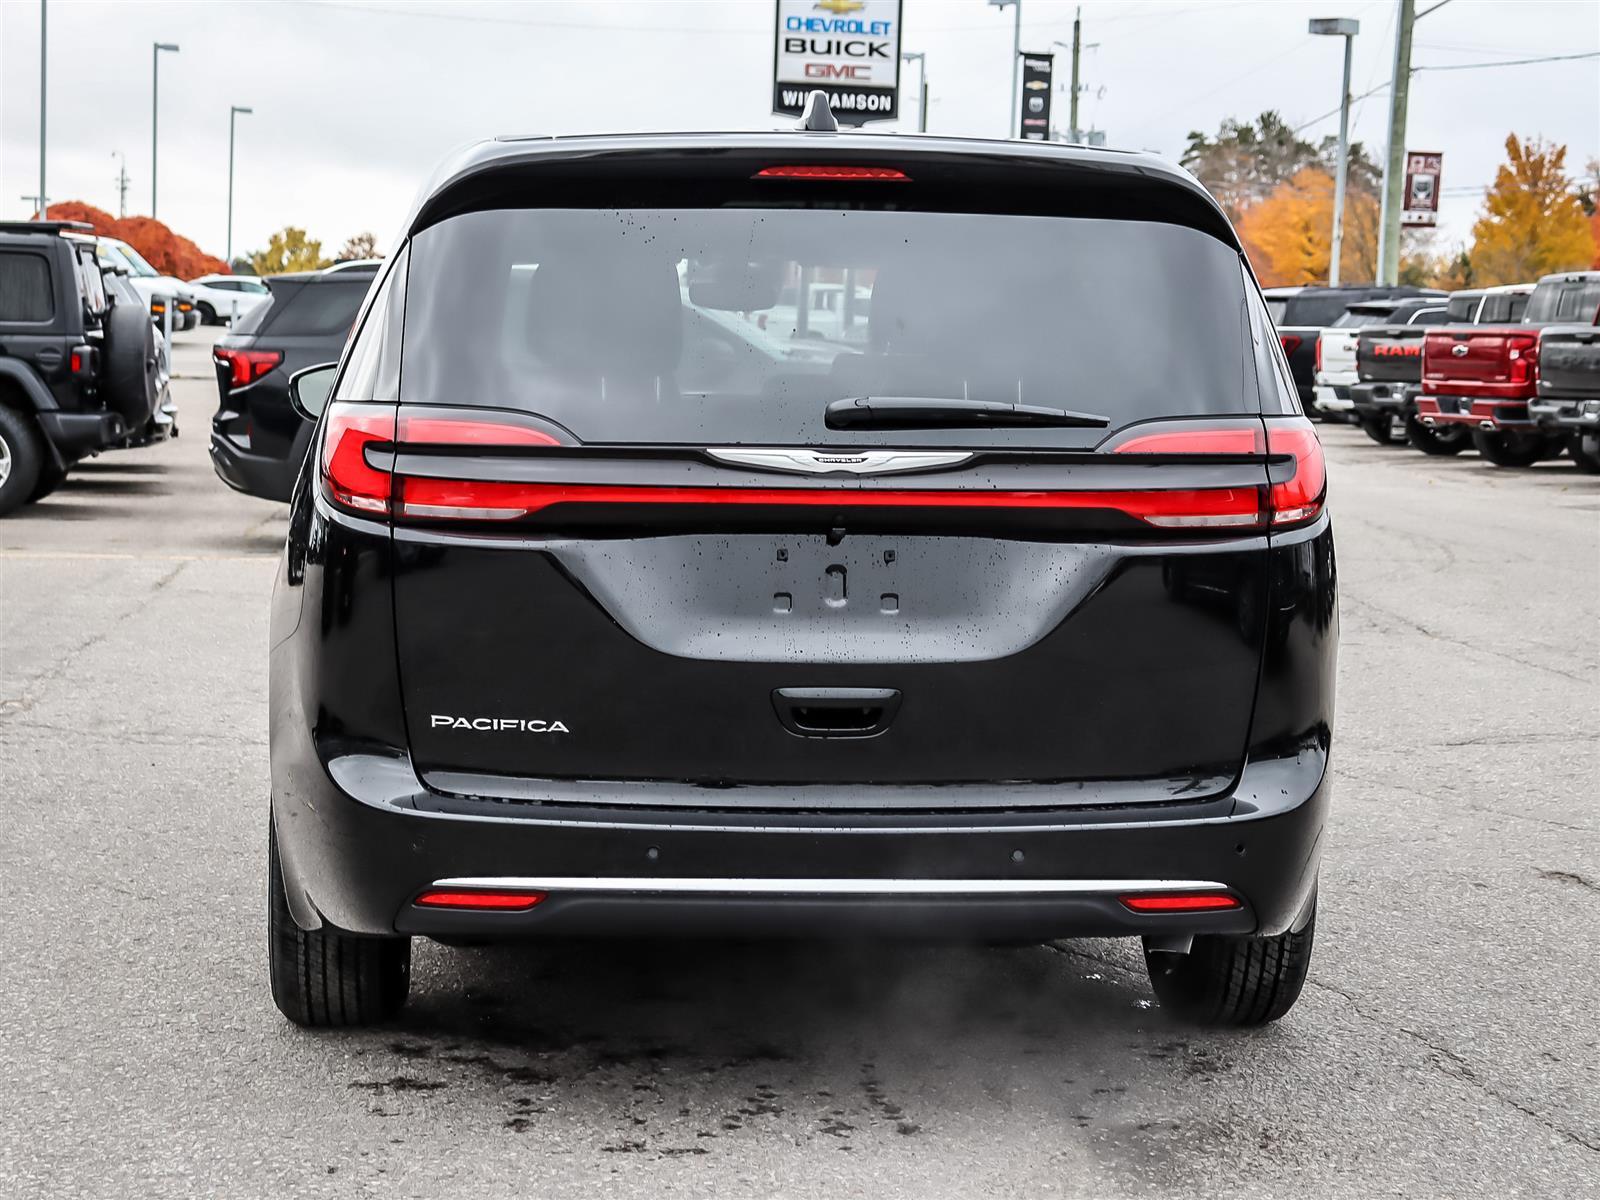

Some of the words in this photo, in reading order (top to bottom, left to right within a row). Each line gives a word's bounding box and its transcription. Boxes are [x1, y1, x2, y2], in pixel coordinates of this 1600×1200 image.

[786, 16, 891, 35] CHEVROLET
[785, 38, 890, 58] BUICK
[804, 63, 871, 80] GMC
[782, 90, 891, 111] WIAMSON
[1375, 345, 1420, 356] RAM
[430, 714, 569, 733] PACIFICA
